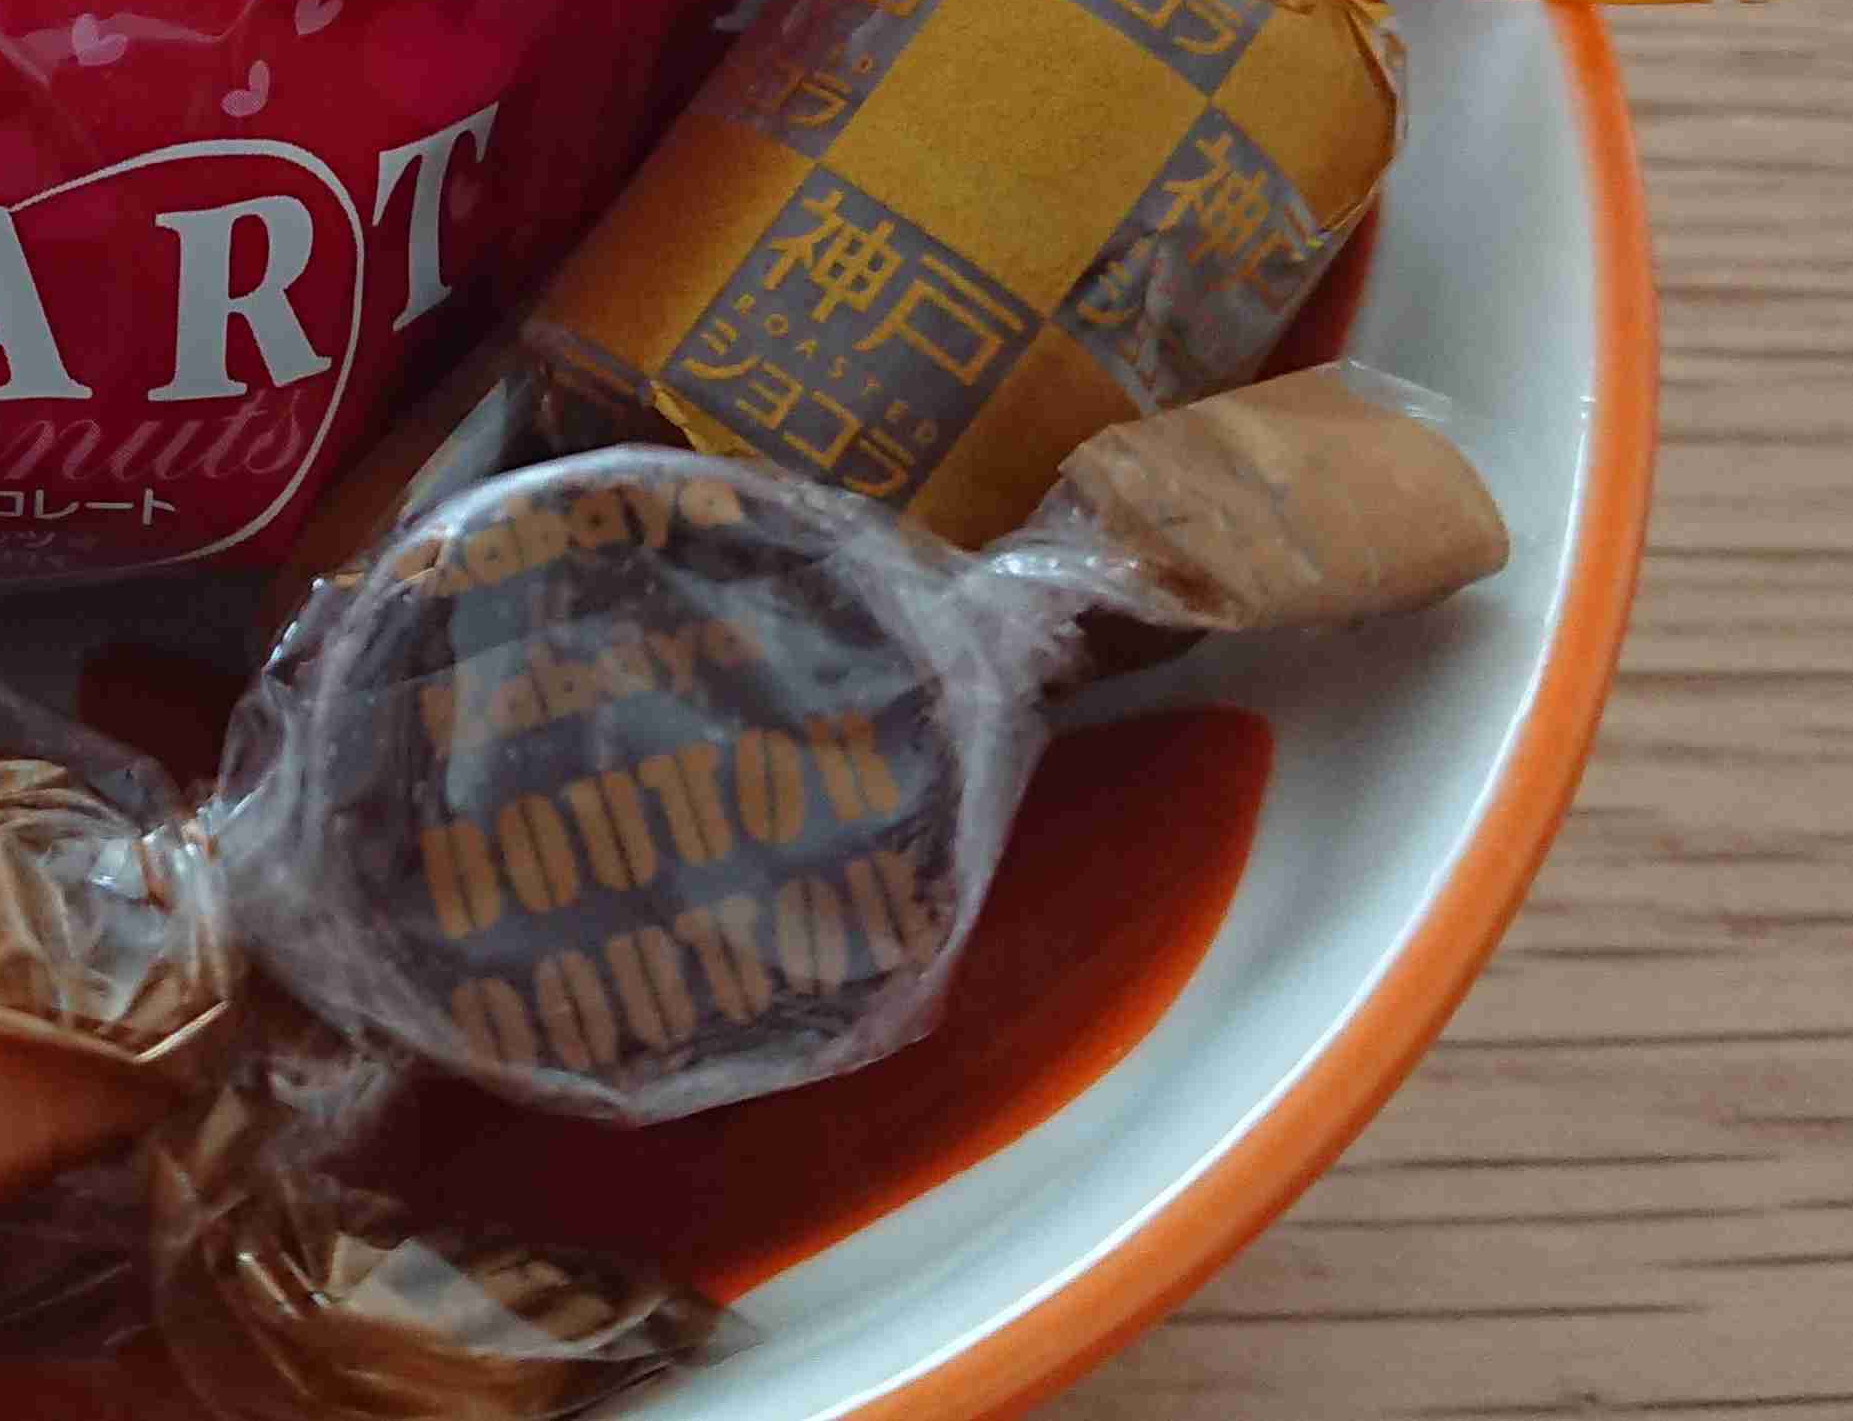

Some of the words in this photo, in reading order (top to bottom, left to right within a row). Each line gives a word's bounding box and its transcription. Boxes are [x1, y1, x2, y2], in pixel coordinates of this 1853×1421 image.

[738, 291, 939, 448] ROASTED
[762, 188, 1026, 387] 神戸
[681, 321, 916, 499] ショコラ
